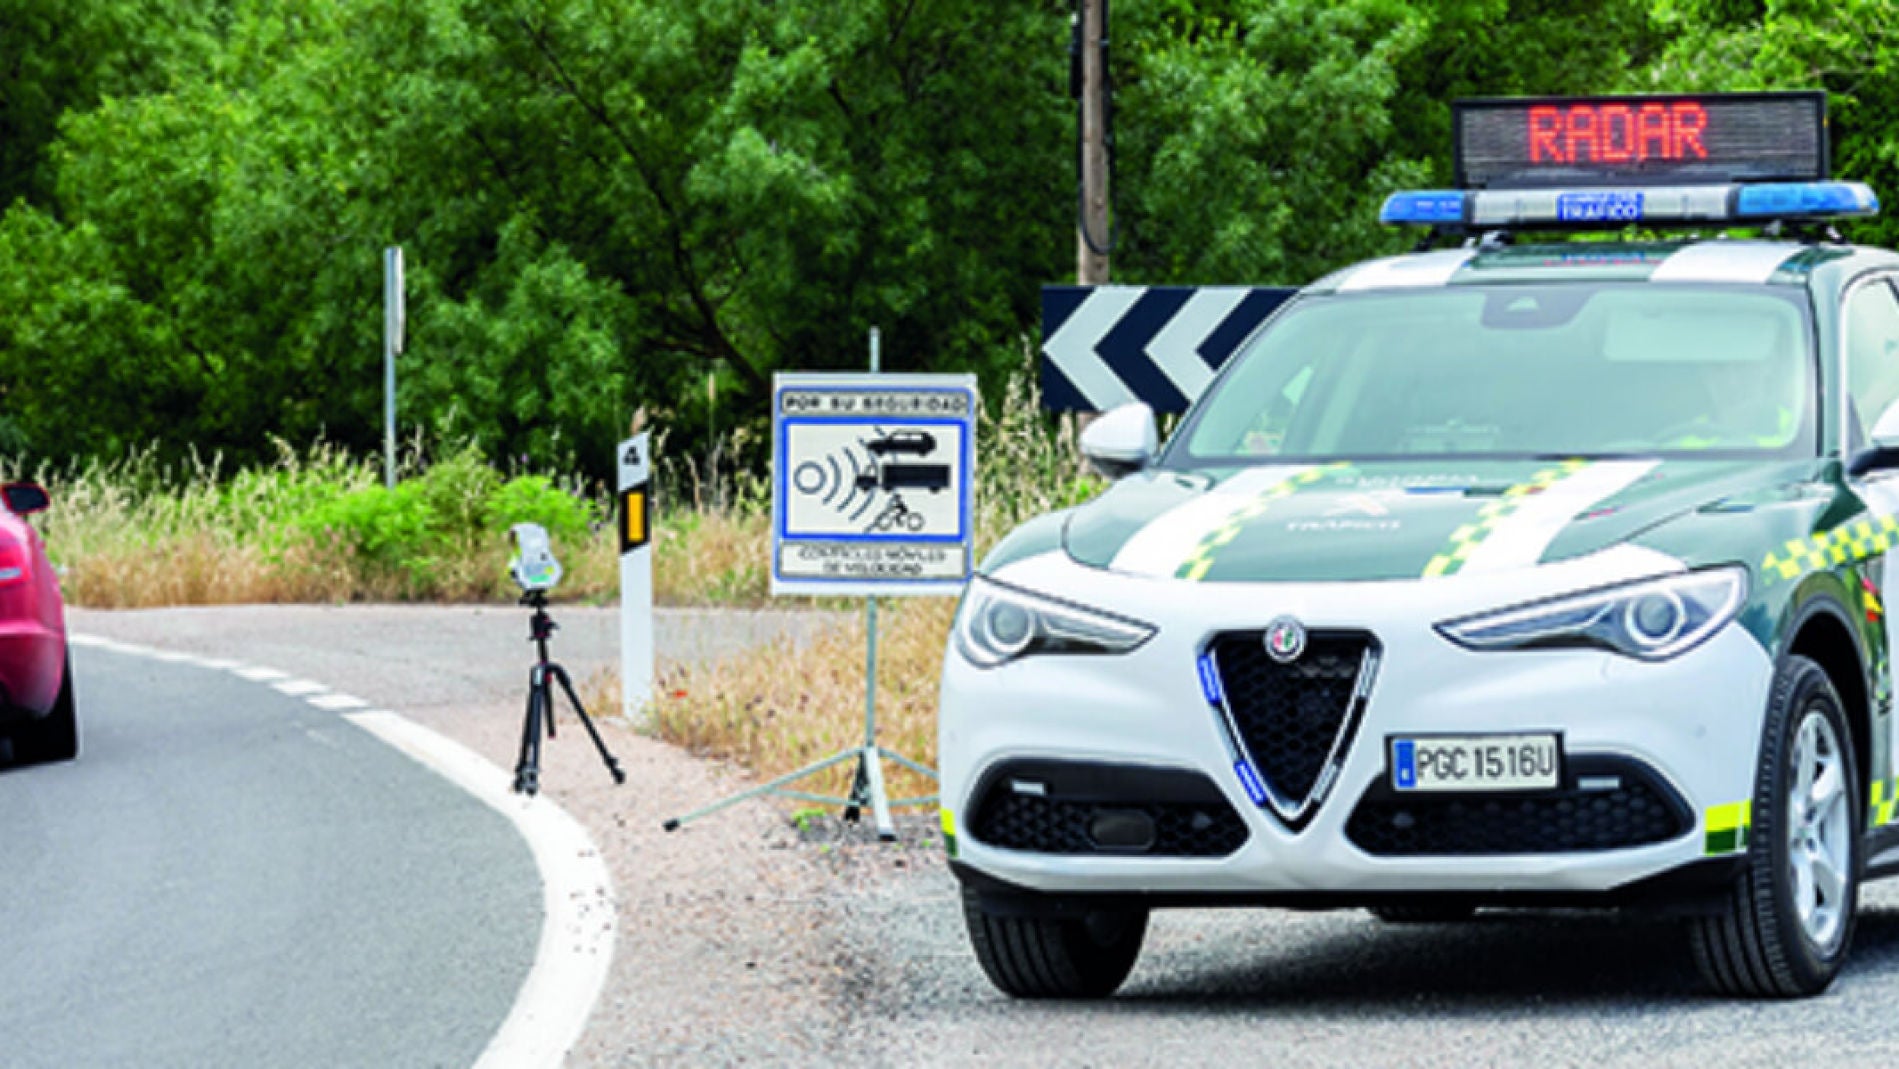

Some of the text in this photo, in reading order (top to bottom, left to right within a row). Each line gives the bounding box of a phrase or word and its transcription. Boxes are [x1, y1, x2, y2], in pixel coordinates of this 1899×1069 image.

[1527, 101, 1708, 163] RADAR
[785, 395, 967, 412] POR SU SEGURIDAD
[623, 445, 641, 466] 4
